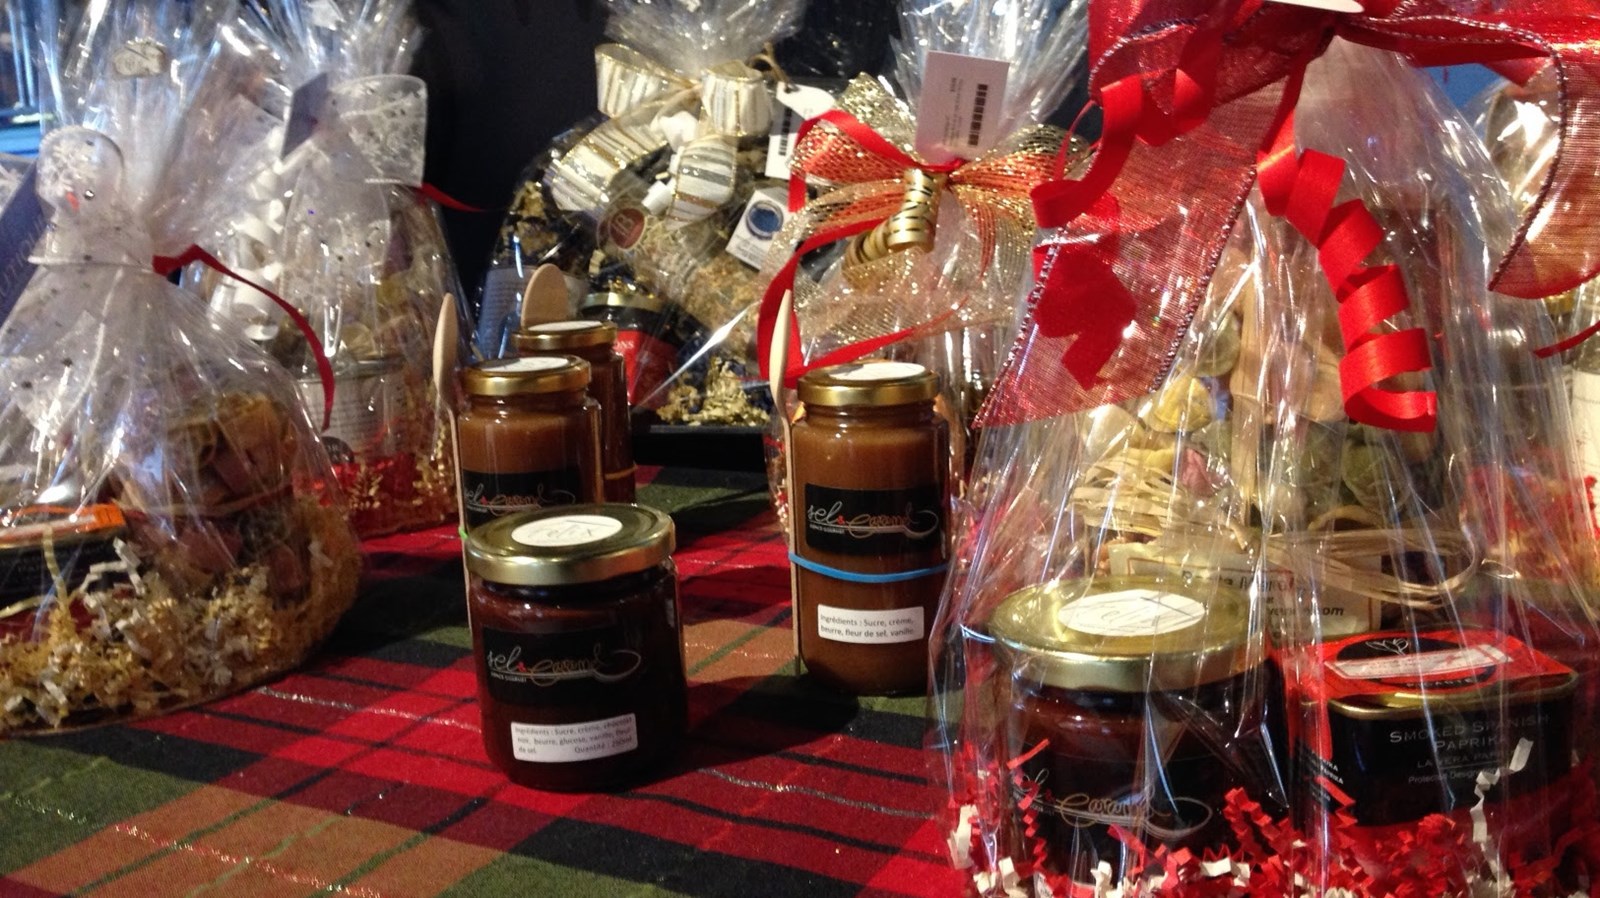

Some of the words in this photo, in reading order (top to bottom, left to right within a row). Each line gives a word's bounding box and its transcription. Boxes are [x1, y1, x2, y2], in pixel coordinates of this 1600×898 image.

[820, 614, 858, 626] Ingrédients
[863, 618, 887, 627] Sucre,
[888, 617, 914, 626] crème,
[820, 625, 844, 636] beurre,
[845, 627, 862, 637] fleur
[864, 628, 874, 637] de
[515, 726, 549, 736] Ingrédients
[554, 728, 575, 736] Sucre,
[574, 743, 605, 754] Quantité
